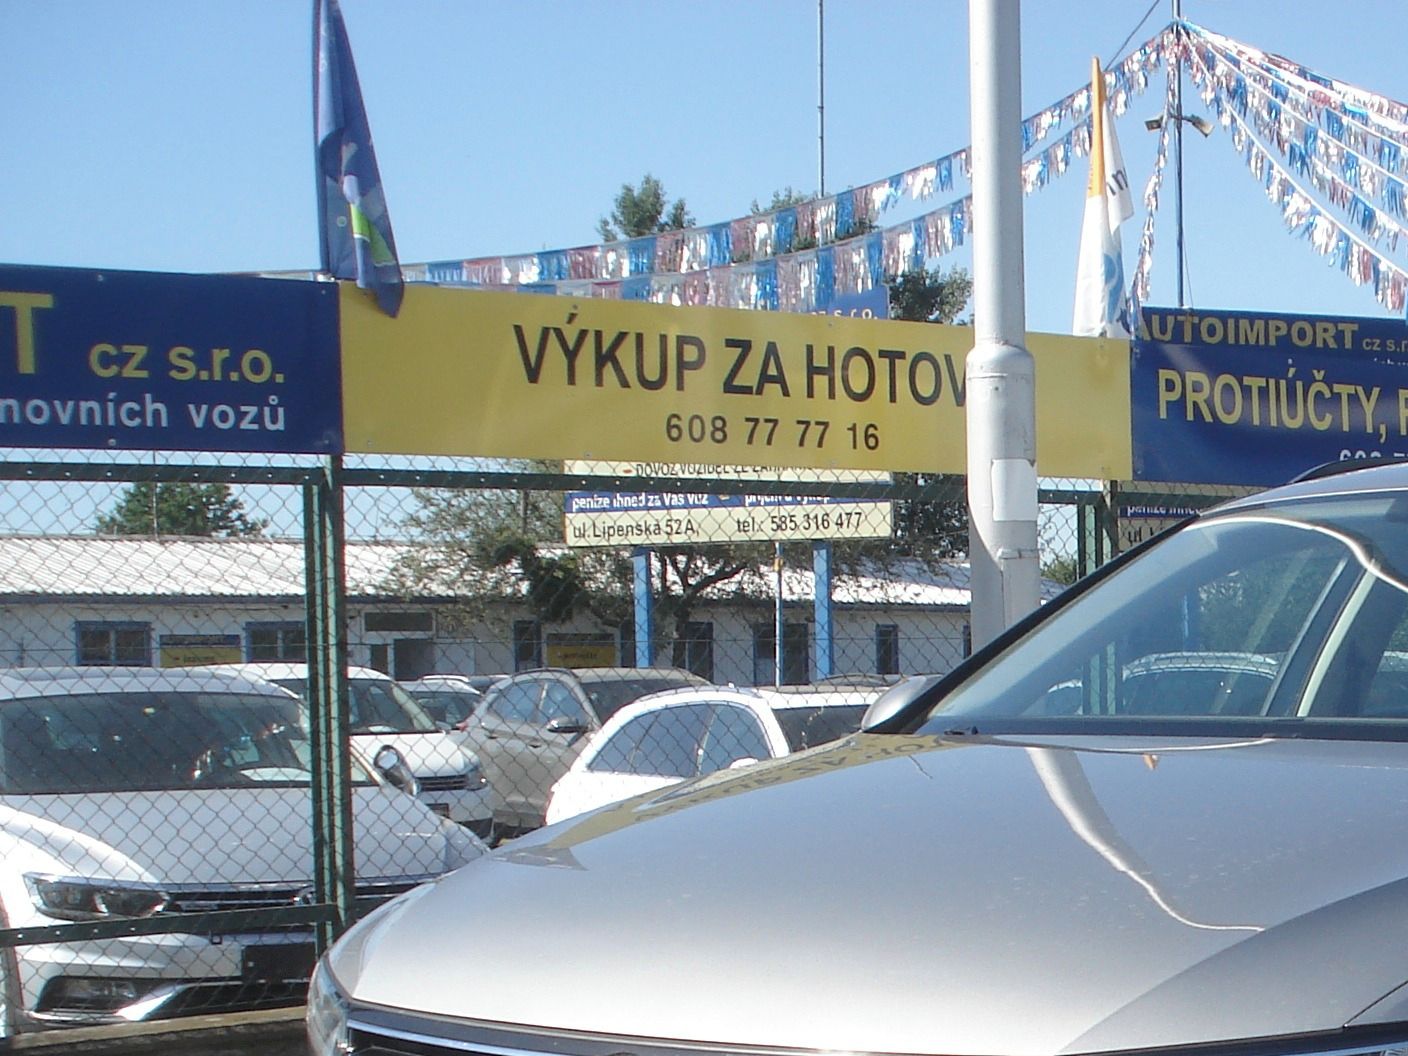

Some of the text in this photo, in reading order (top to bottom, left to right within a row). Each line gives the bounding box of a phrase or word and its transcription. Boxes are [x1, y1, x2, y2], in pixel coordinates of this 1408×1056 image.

[90, 342, 149, 378] cz
[168, 346, 285, 383] s.r.o.
[513, 312, 967, 407] VÝKUP ZA HOTOV
[1362, 338, 1381, 351] cz
[188, 395, 285, 431] vozů
[1157, 367, 1387, 444] PROTIÚČTY,
[666, 413, 880, 451] 608 77 77 16
[593, 519, 661, 541] Lipenská
[770, 514, 798, 532] 585
[803, 513, 830, 531] 316
[835, 511, 862, 530] 477
